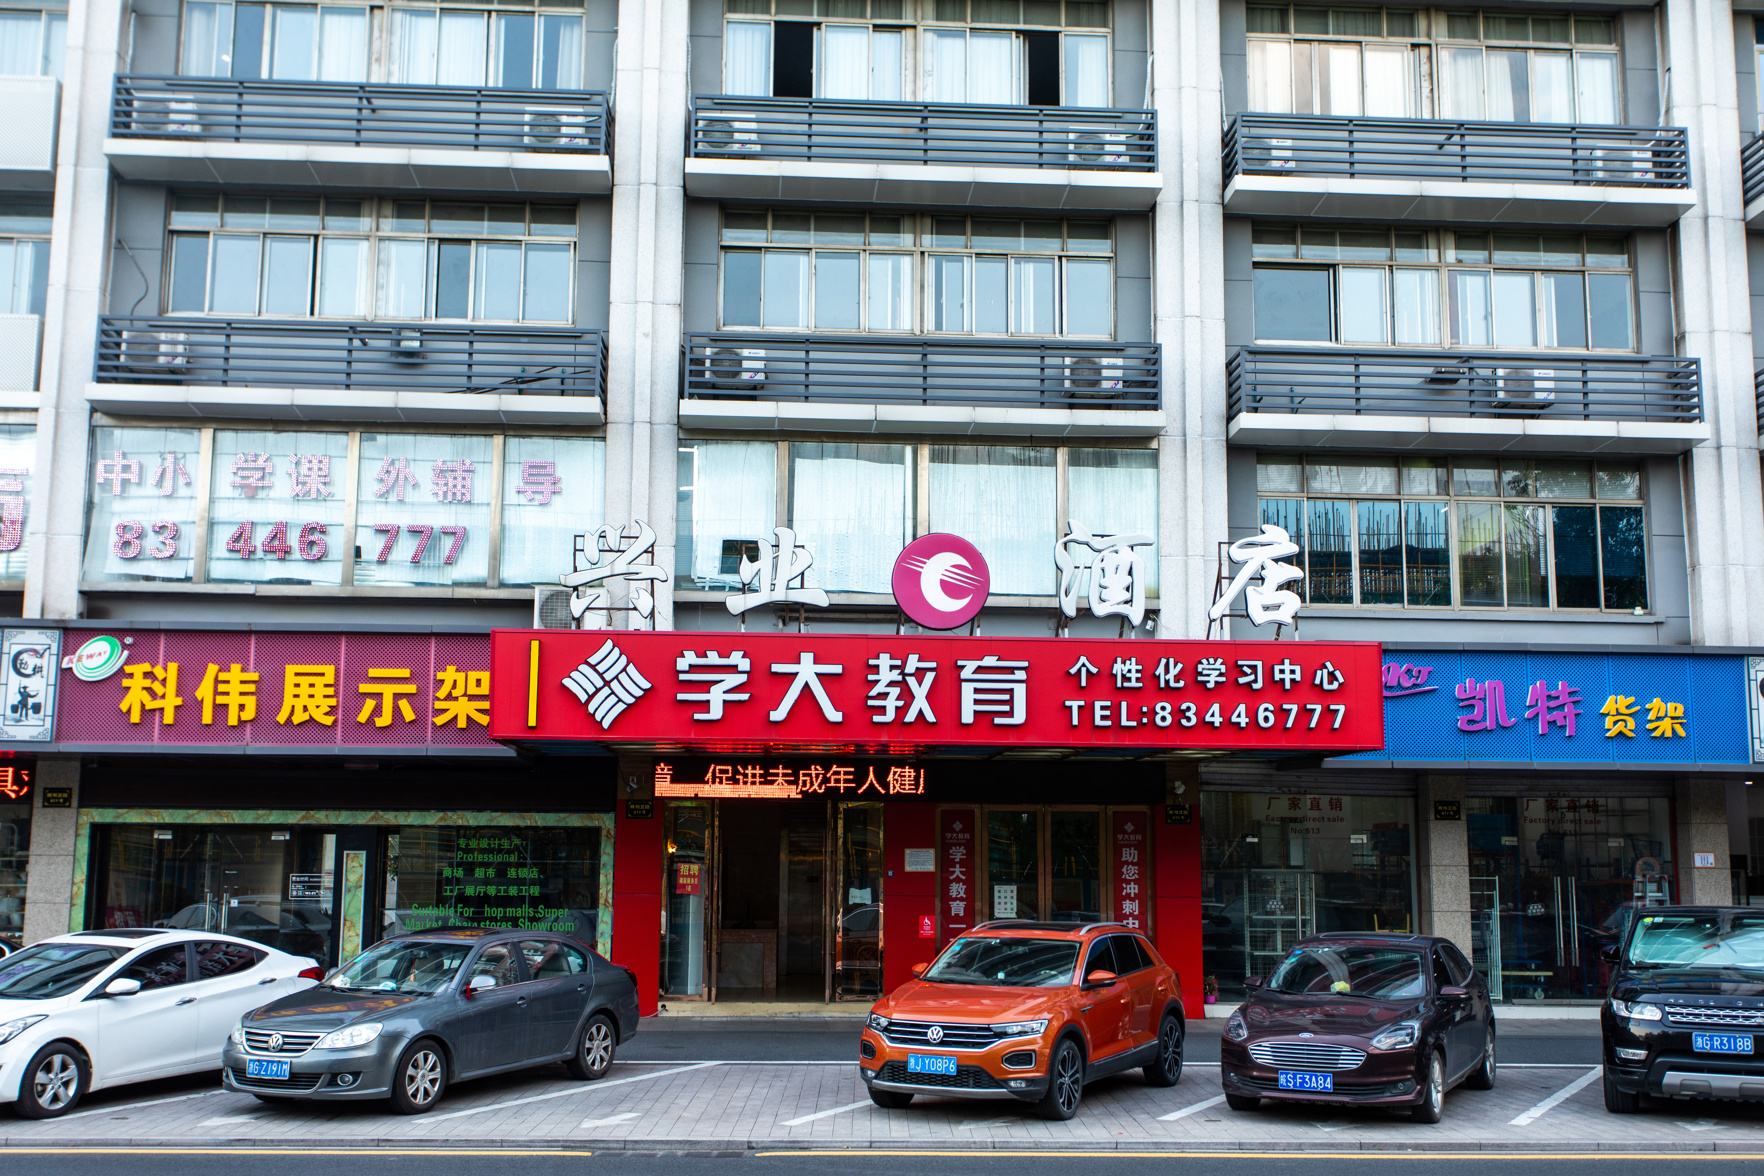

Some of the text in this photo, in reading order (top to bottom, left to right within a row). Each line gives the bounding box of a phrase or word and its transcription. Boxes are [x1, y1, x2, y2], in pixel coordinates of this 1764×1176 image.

[97, 449, 563, 505] 中小学课外辅导
[112, 519, 467, 565] 83 446 777
[1053, 517, 1305, 628] 酒店
[675, 649, 1030, 727] 学大教育
[1068, 654, 1345, 692] 个性化学习中心
[118, 662, 490, 730] 科伟展示架
[1064, 699, 1346, 730] TEL:83446777
[704, 763, 925, 795] 促进未成年人健
[1266, 796, 1343, 812] 厂家直销
[1300, 815, 1325, 823] direct
[1327, 815, 1344, 823] sale
[1524, 798, 1600, 814] 厂家直销
[1523, 816, 1555, 826] Factory
[1557, 817, 1582, 825] direct
[457, 904, 474, 917] For
